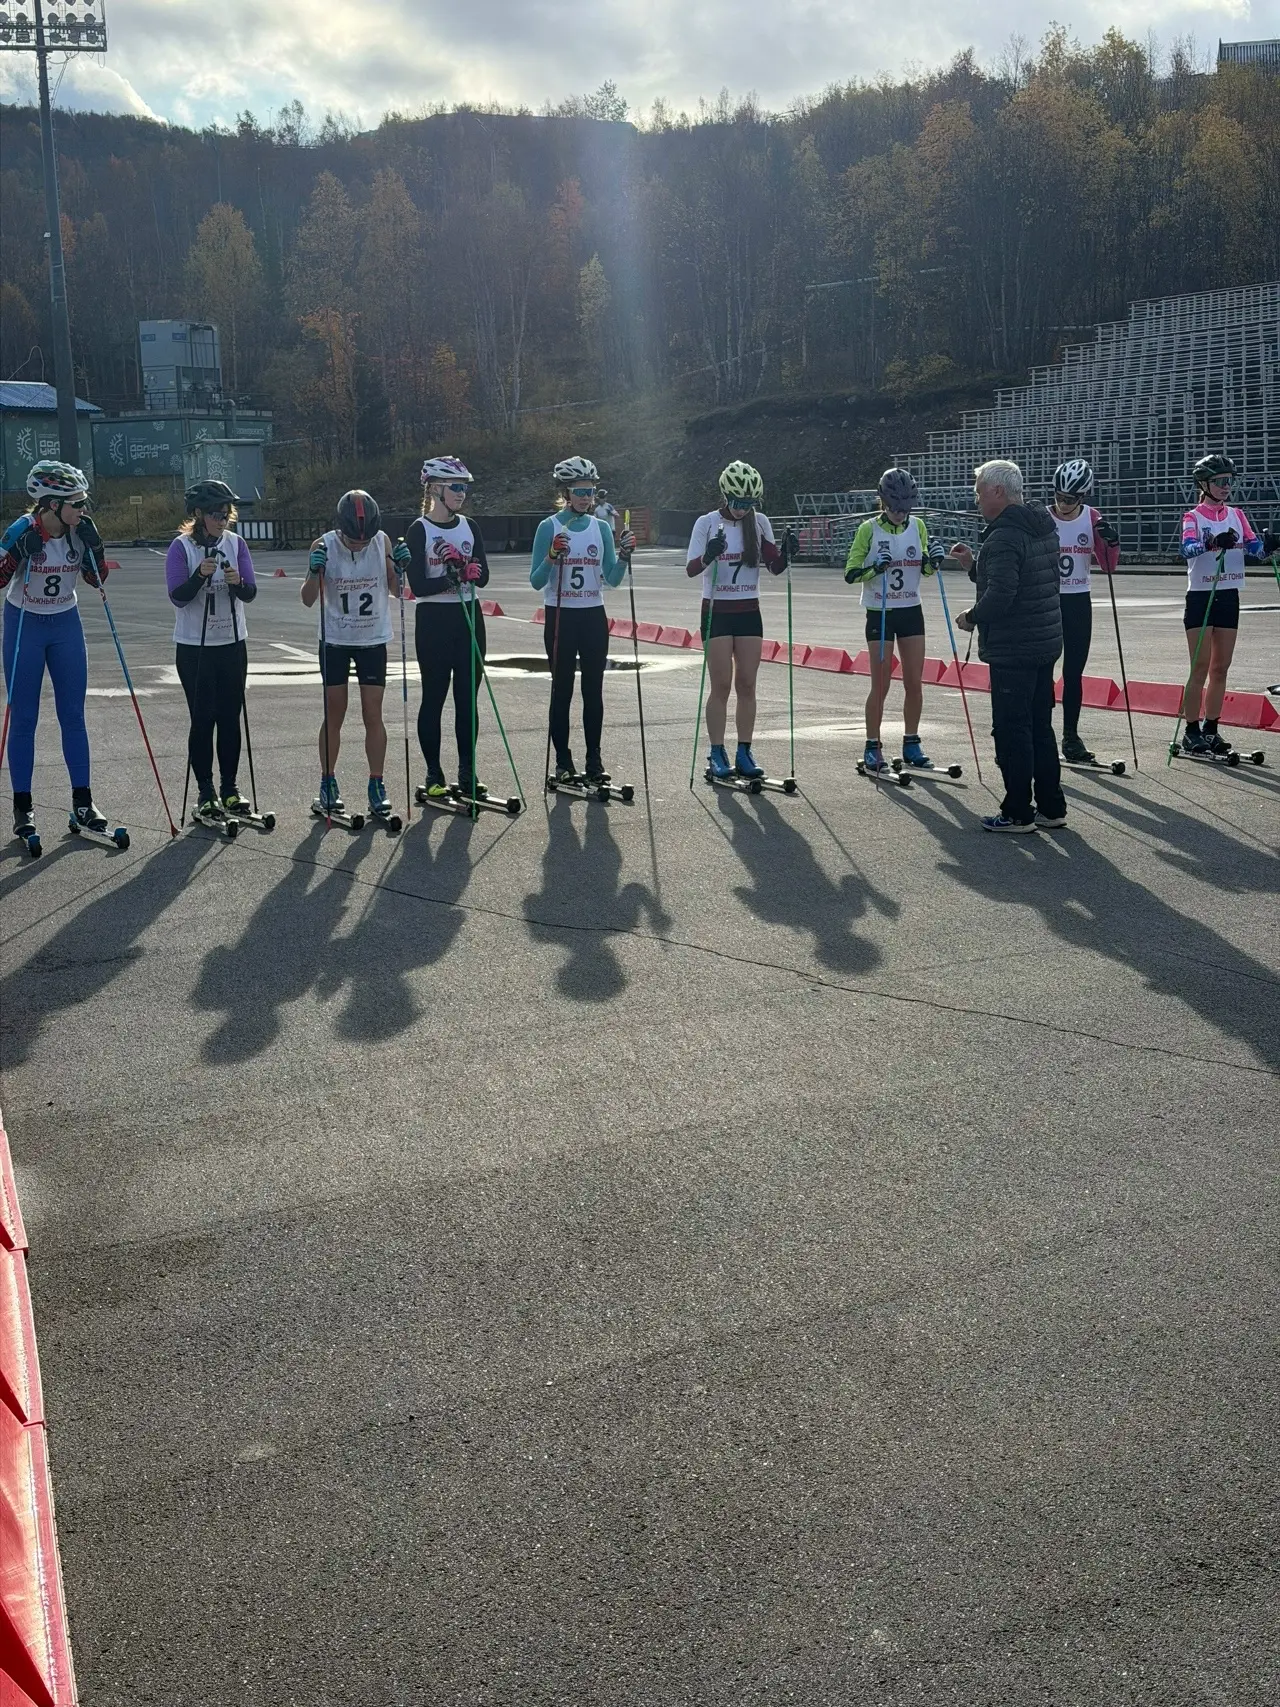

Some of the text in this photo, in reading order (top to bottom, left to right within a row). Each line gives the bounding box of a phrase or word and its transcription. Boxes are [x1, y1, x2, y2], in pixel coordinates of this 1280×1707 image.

[570, 566, 585, 590] 5
[728, 560, 744, 584] 7
[1059, 555, 1074, 578] 9
[43, 574, 62, 597] 8
[889, 568, 904, 591] 3
[340, 592, 373, 616] 12
